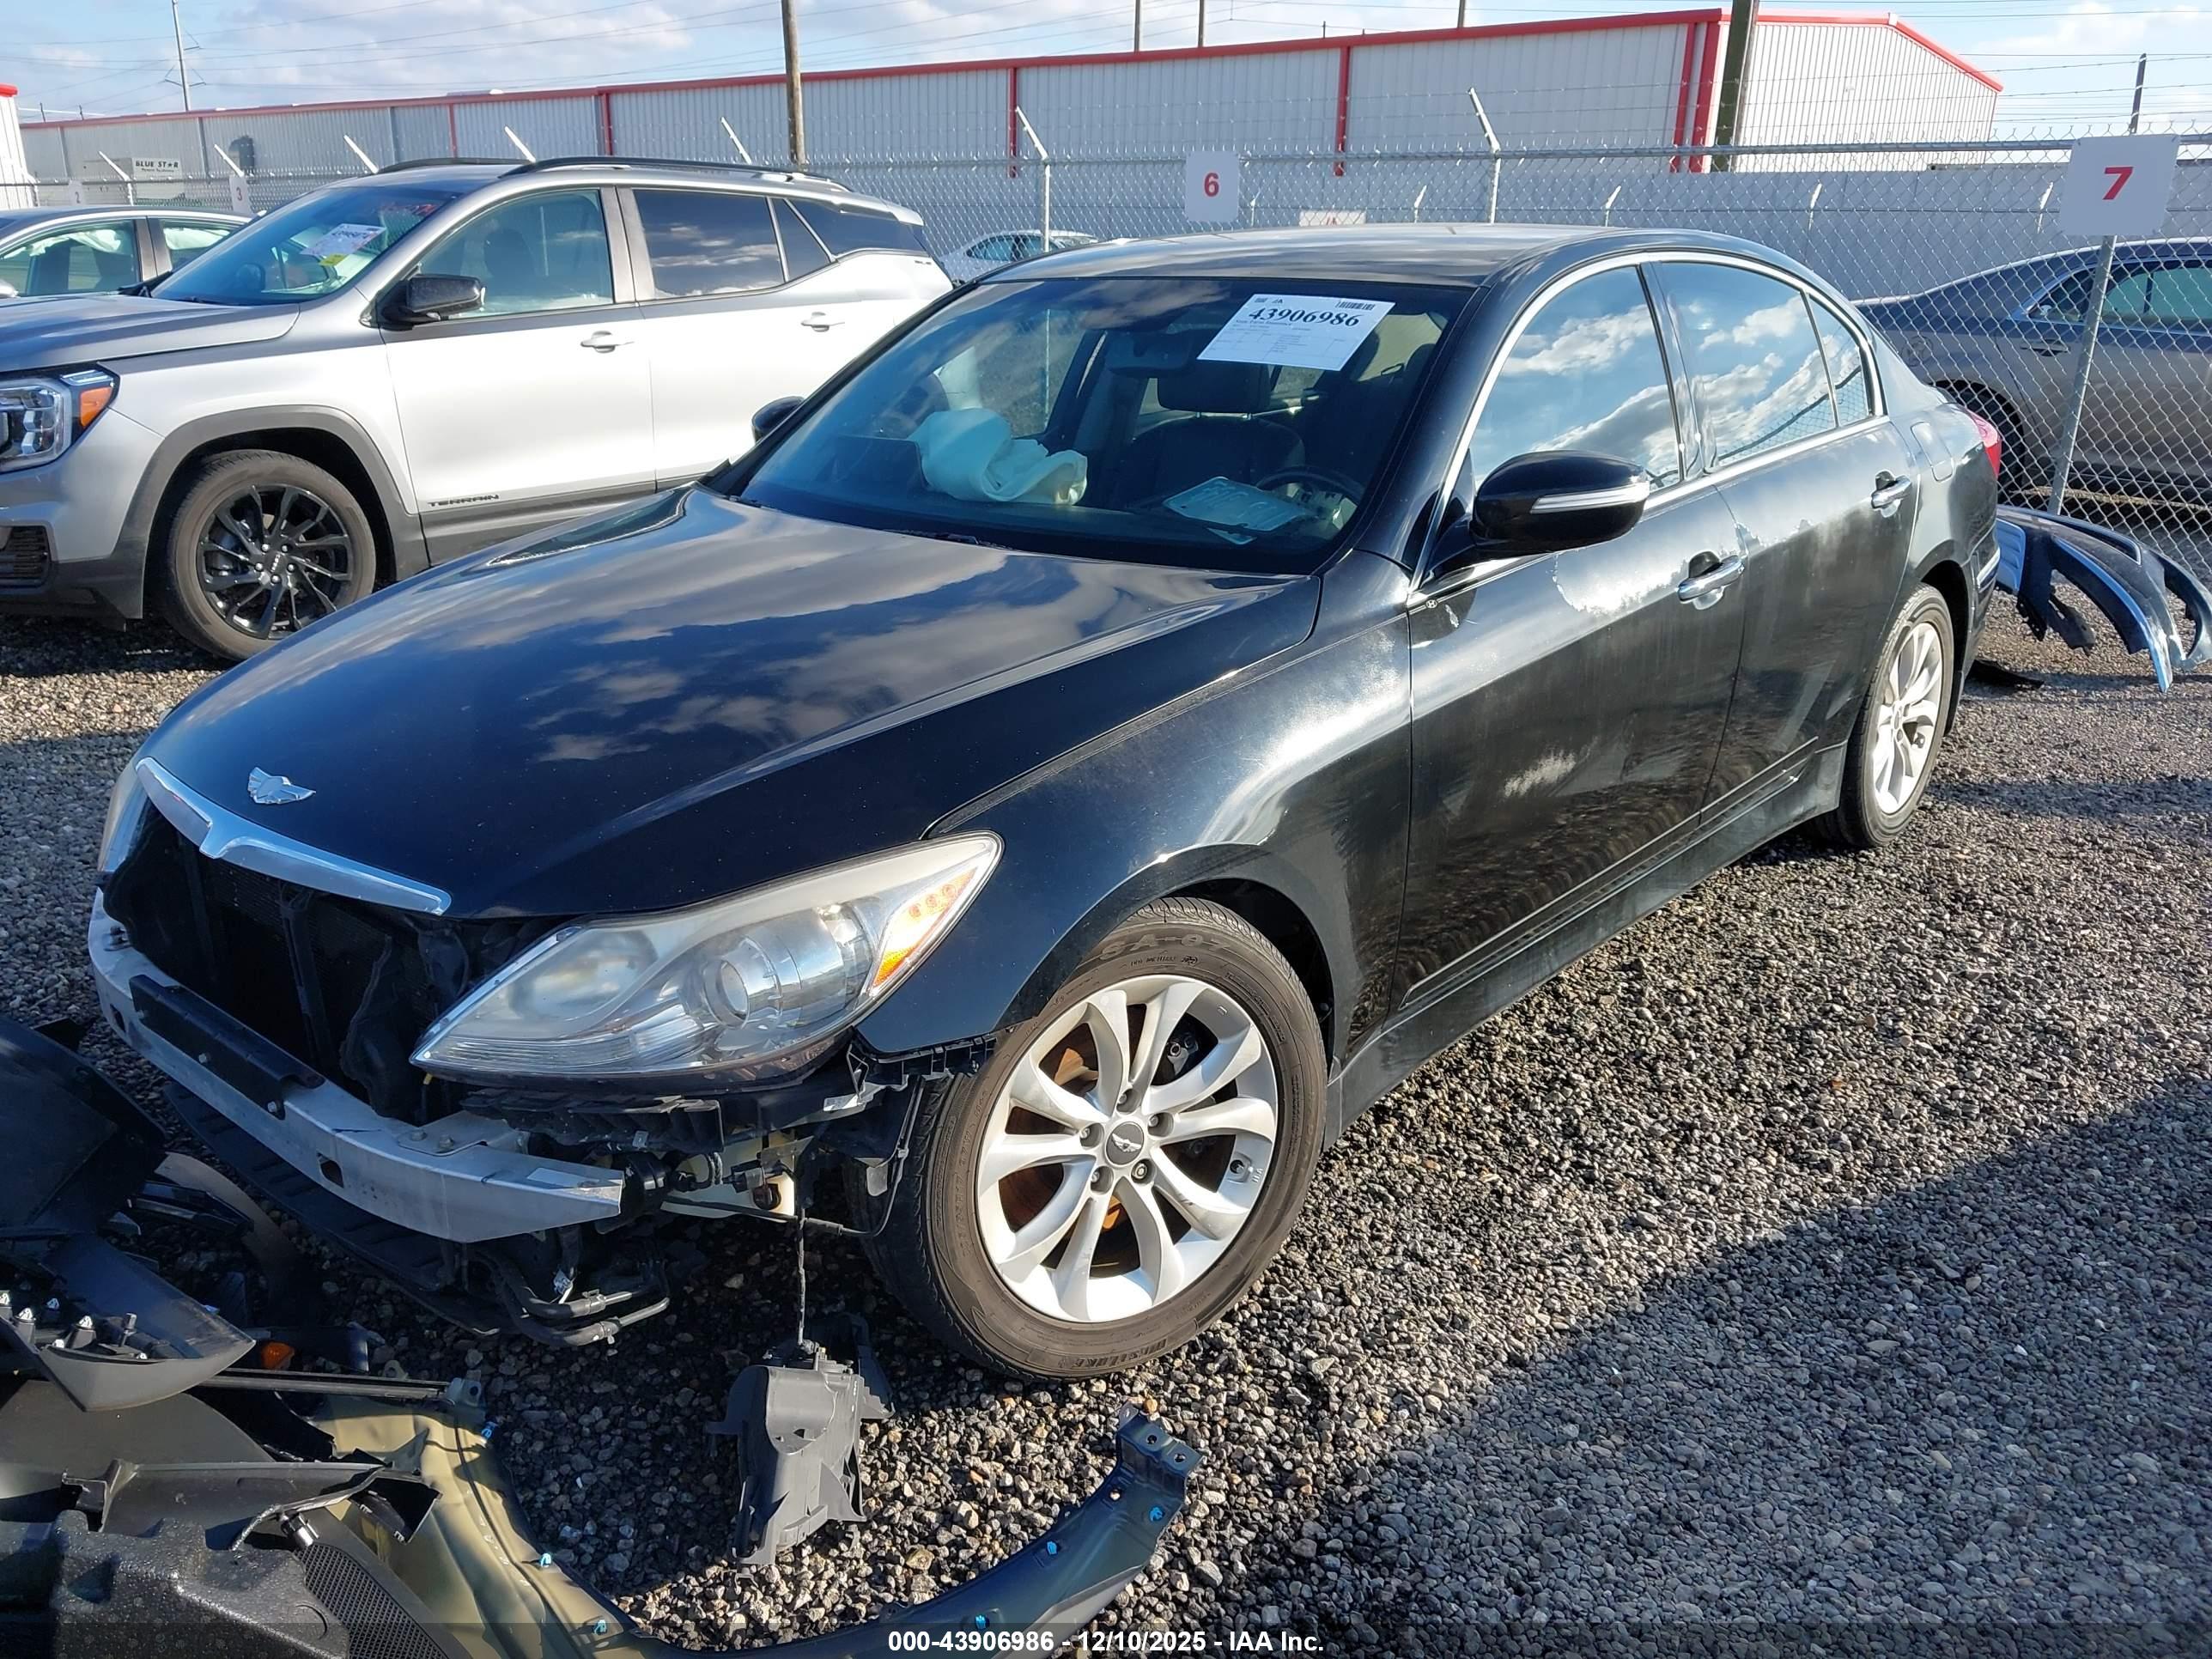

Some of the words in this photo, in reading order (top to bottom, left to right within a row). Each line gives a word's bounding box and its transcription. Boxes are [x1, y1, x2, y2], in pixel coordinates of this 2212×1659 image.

[1204, 173, 1219, 198] 6
[2102, 166, 2133, 200] 7
[75, 191, 81, 204] 2
[235, 186, 243, 202] 3
[1249, 307, 1363, 327] 43906986
[428, 495, 499, 507] TERRAIN
